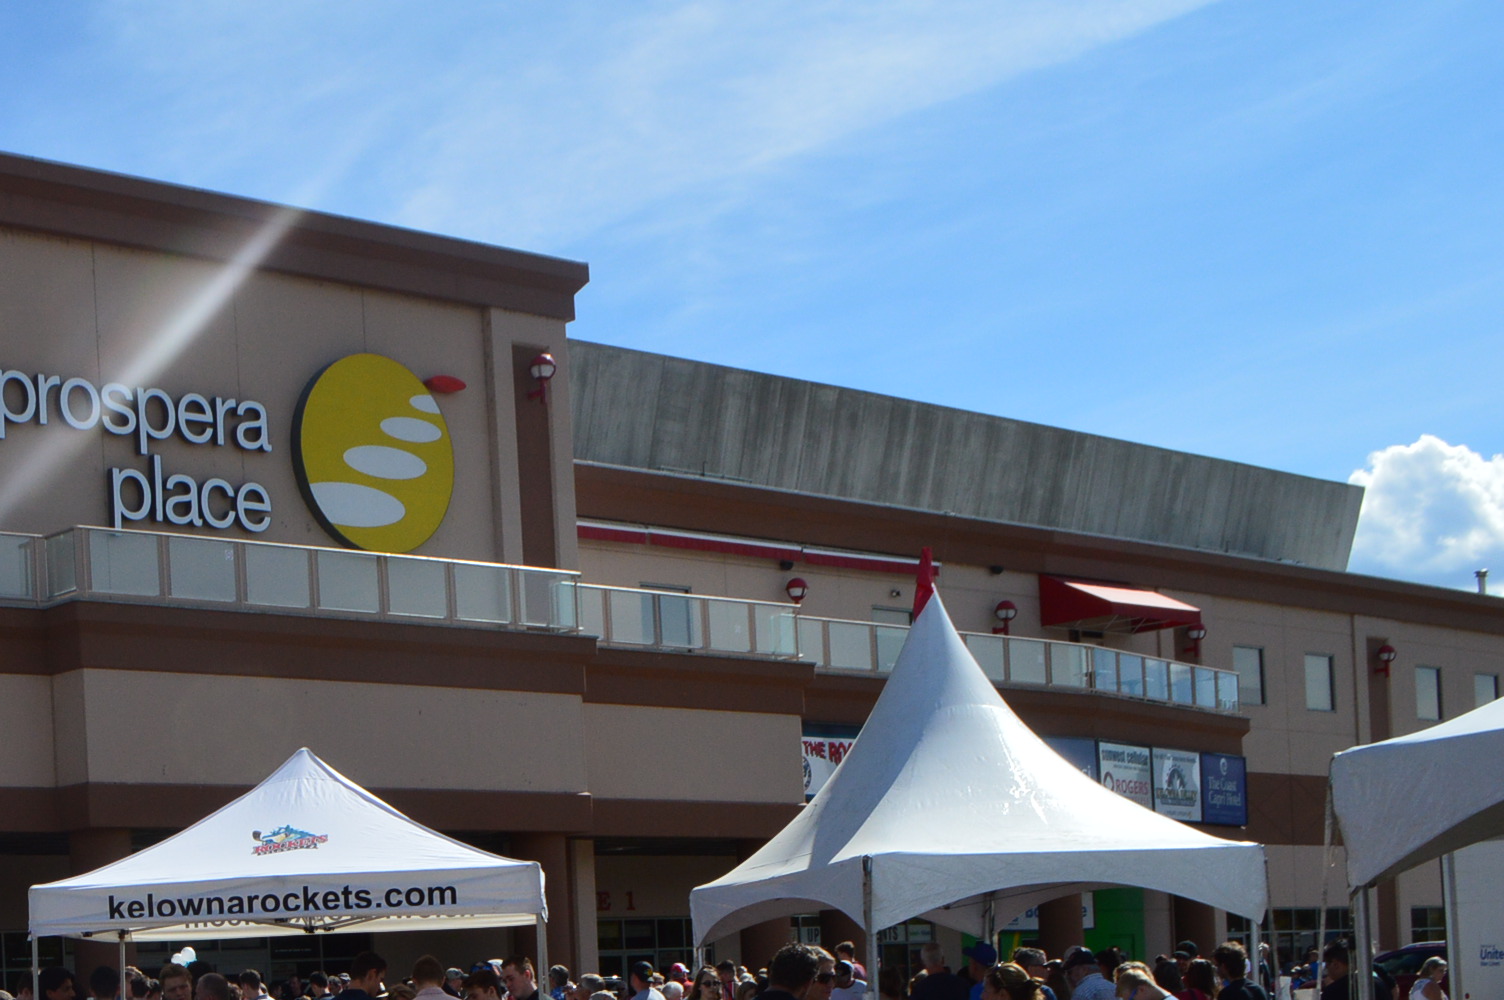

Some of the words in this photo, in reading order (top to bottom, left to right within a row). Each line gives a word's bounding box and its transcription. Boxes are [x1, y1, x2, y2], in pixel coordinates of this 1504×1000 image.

[109, 454, 272, 535] place
[802, 741, 826, 759] THE
[1115, 779, 1149, 796] ROGERS
[107, 885, 458, 920] kelownarockets.com
[807, 928, 820, 943] UP
[1480, 948, 1504, 961] Unite
